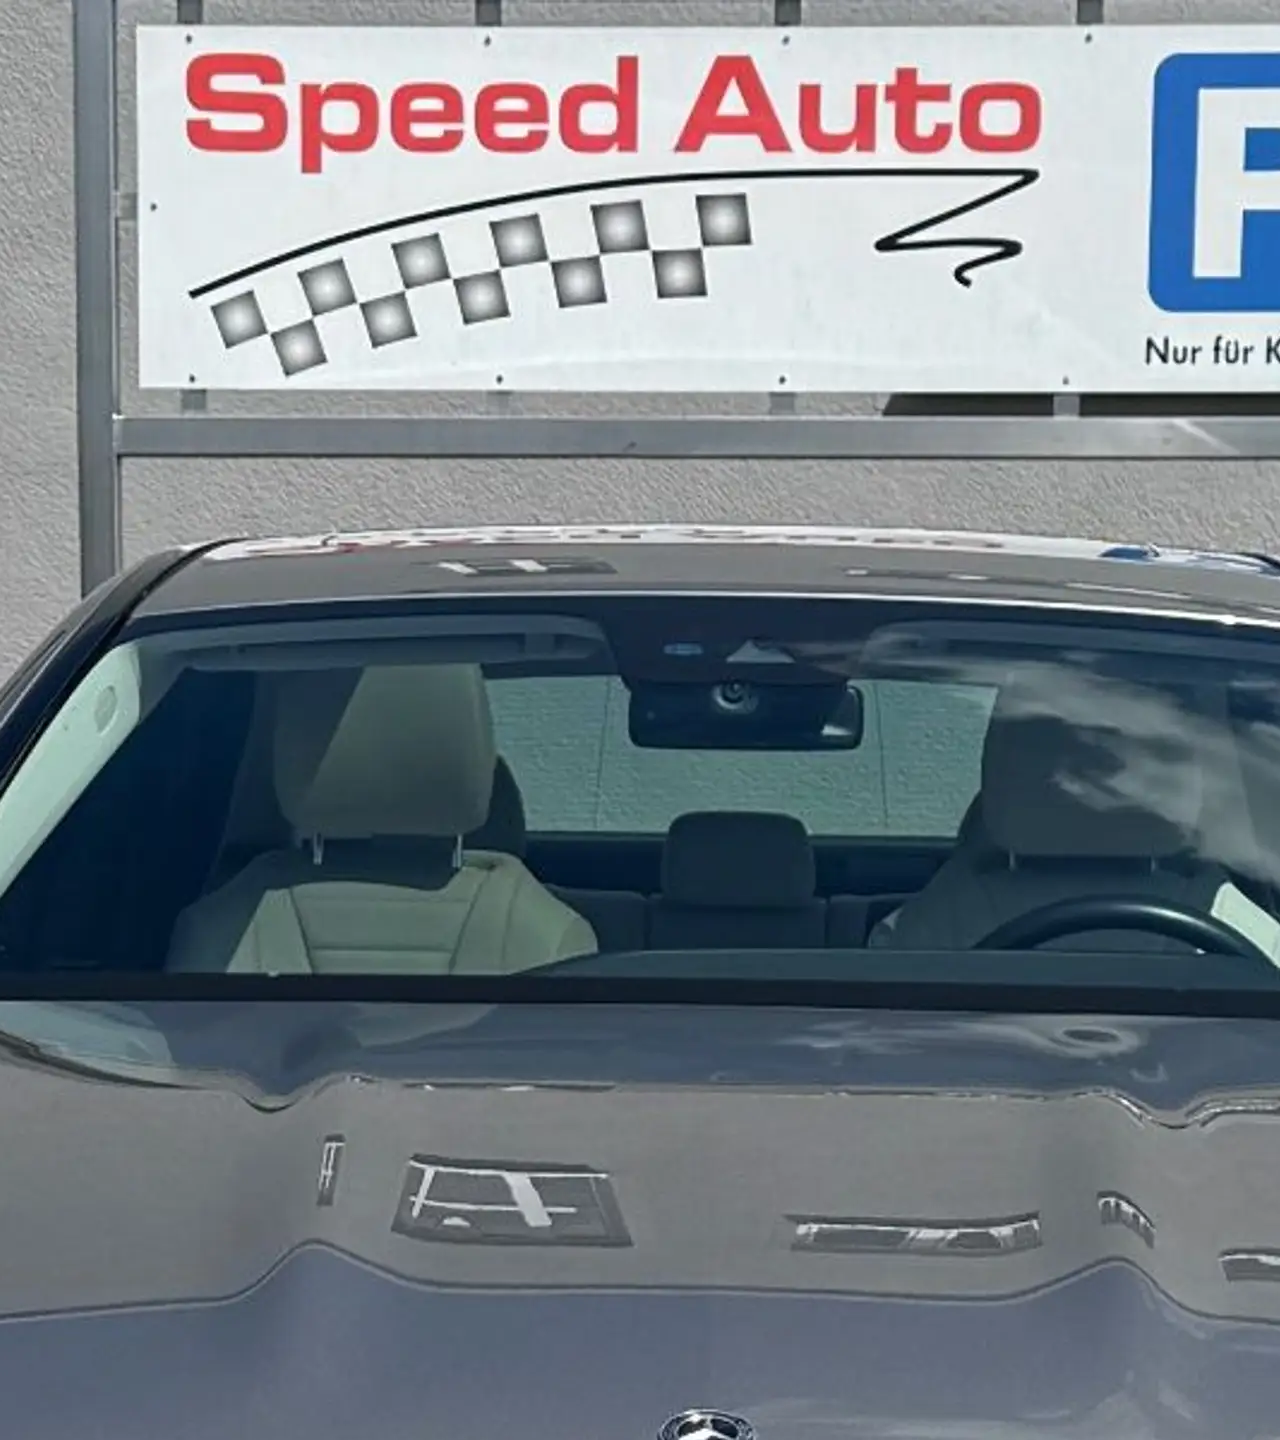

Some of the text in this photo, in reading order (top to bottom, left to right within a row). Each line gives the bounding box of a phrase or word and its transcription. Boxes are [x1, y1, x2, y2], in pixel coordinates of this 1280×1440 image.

[184, 52, 1043, 175] Speed Auto
[1145, 336, 1201, 365] Nur
[1212, 335, 1254, 364] für
